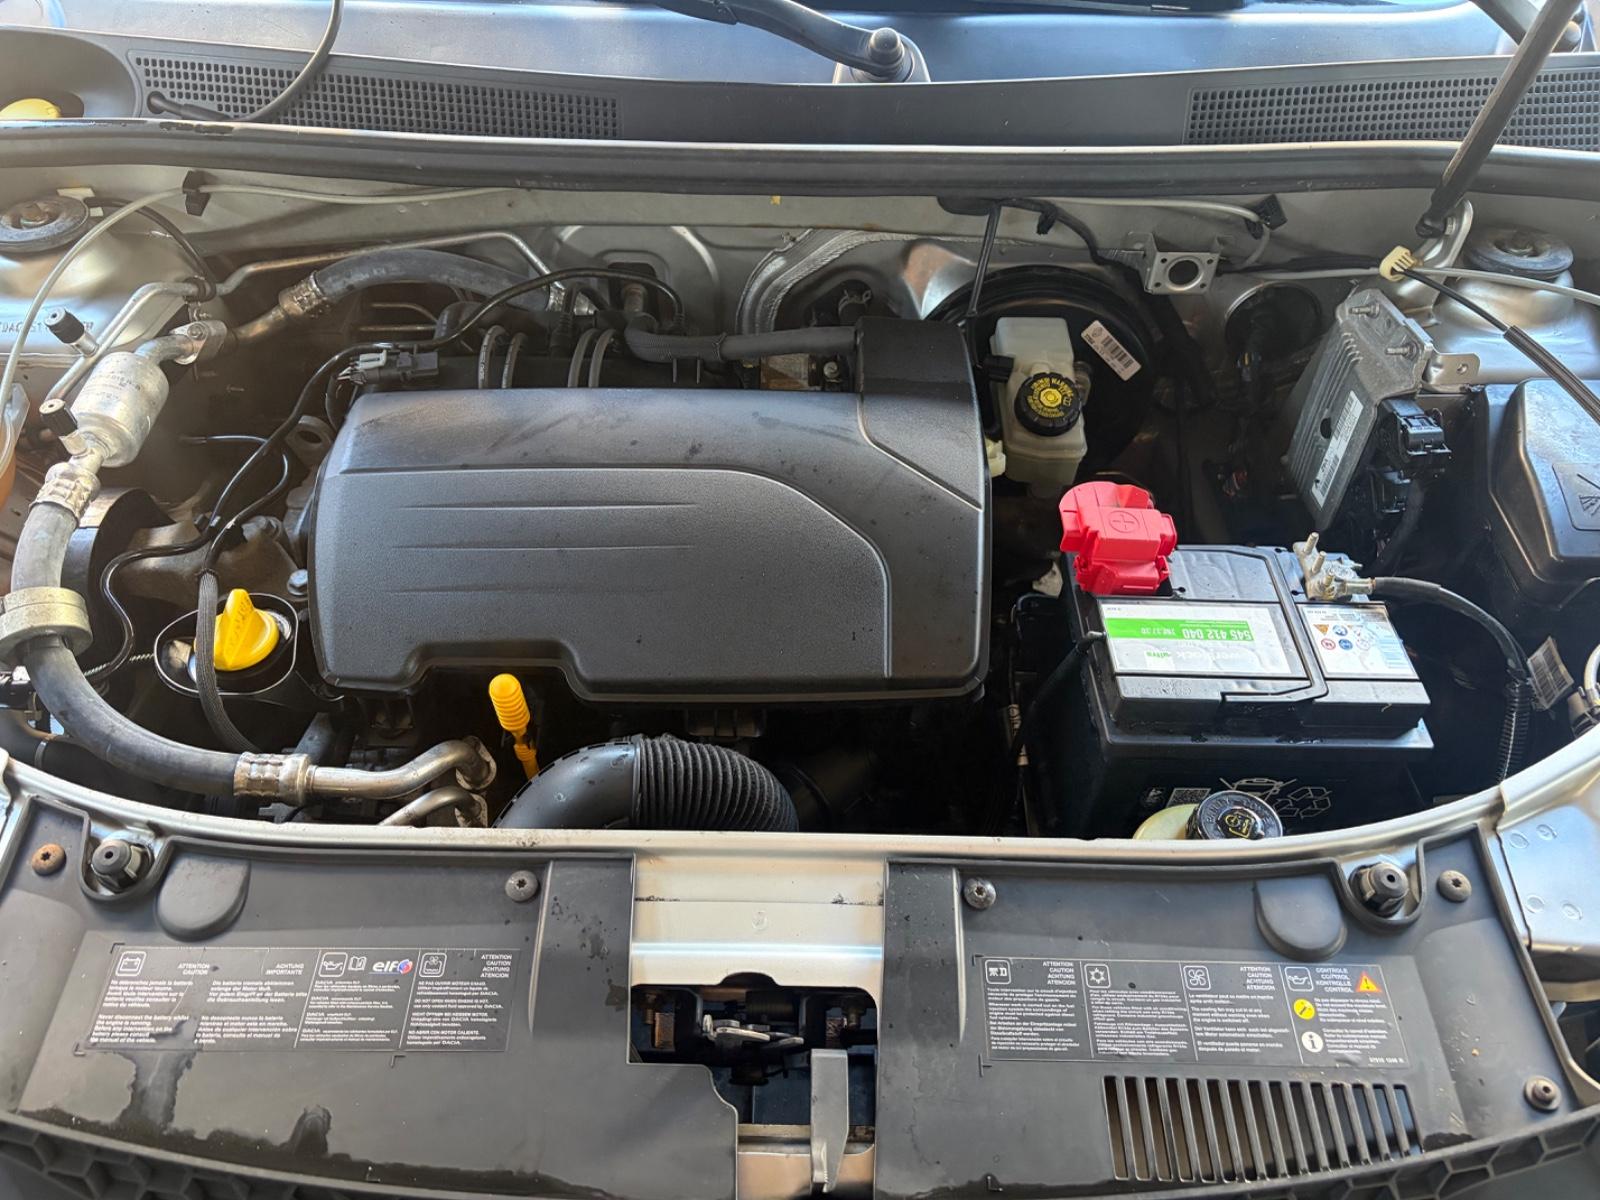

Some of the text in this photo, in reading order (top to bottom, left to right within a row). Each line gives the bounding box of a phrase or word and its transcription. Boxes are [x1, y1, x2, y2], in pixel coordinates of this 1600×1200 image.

[1182, 628, 1204, 639] 040
[1207, 629, 1227, 640] 412
[1230, 630, 1251, 640] 545
[372, 960, 399, 972] elf
